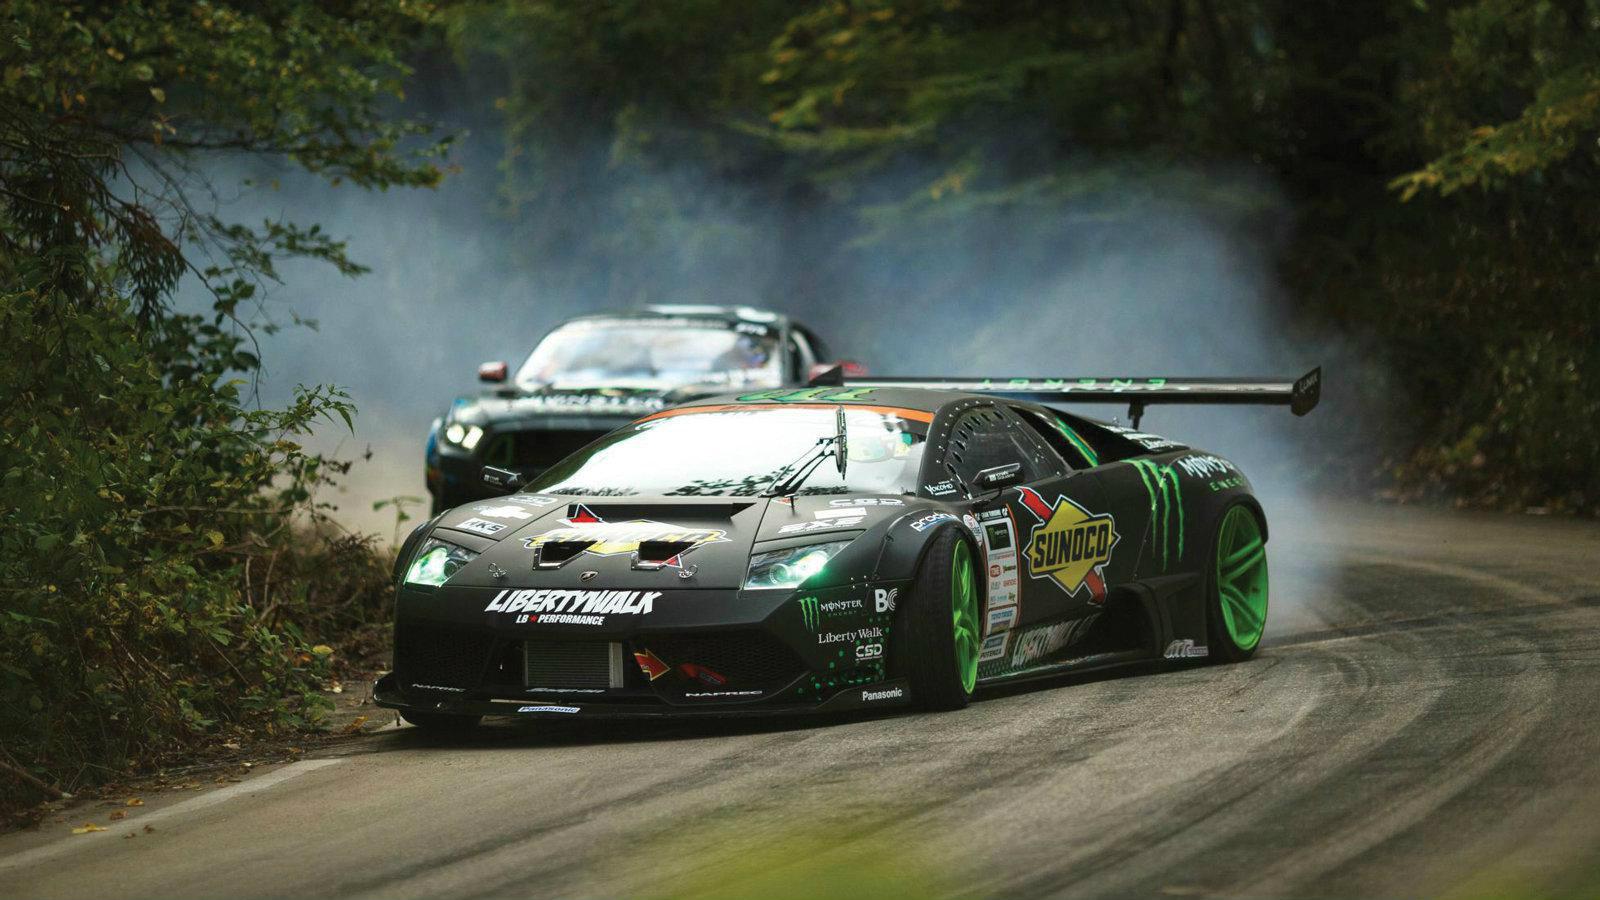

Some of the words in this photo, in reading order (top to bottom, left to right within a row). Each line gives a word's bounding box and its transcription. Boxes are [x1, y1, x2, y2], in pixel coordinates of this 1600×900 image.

[1033, 524, 1109, 568] SUNOCO
[484, 590, 663, 615] LIBERTYWALK
[820, 600, 862, 612] MONSTER
[515, 614, 529, 624] LB
[537, 614, 605, 626] PERFORMANCE
[818, 632, 857, 644] Liberty
[858, 627, 883, 639] Walk
[855, 643, 883, 658] CSD
[862, 687, 903, 701] Panasonic
